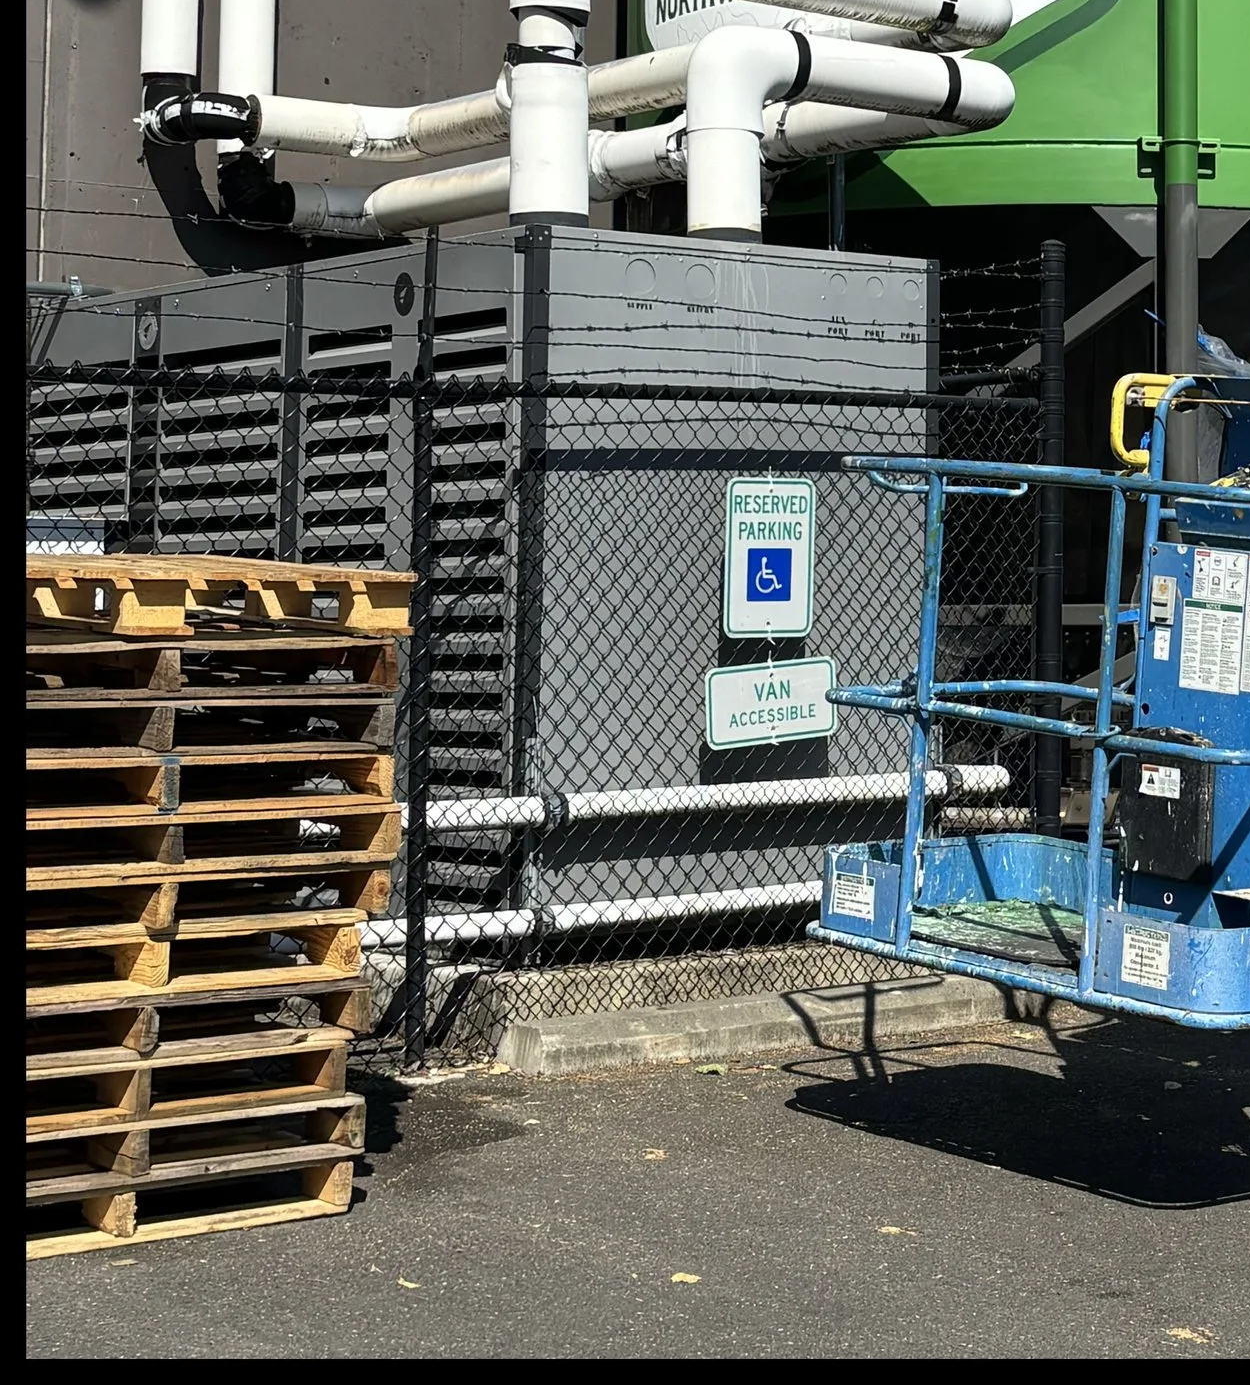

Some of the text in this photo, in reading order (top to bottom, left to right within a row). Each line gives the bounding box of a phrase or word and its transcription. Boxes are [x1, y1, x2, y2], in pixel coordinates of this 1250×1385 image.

[734, 494, 808, 515] RESERVED
[738, 521, 803, 541] PARKING
[754, 679, 791, 701] VAN
[729, 703, 816, 728] ACCESSIBLE
